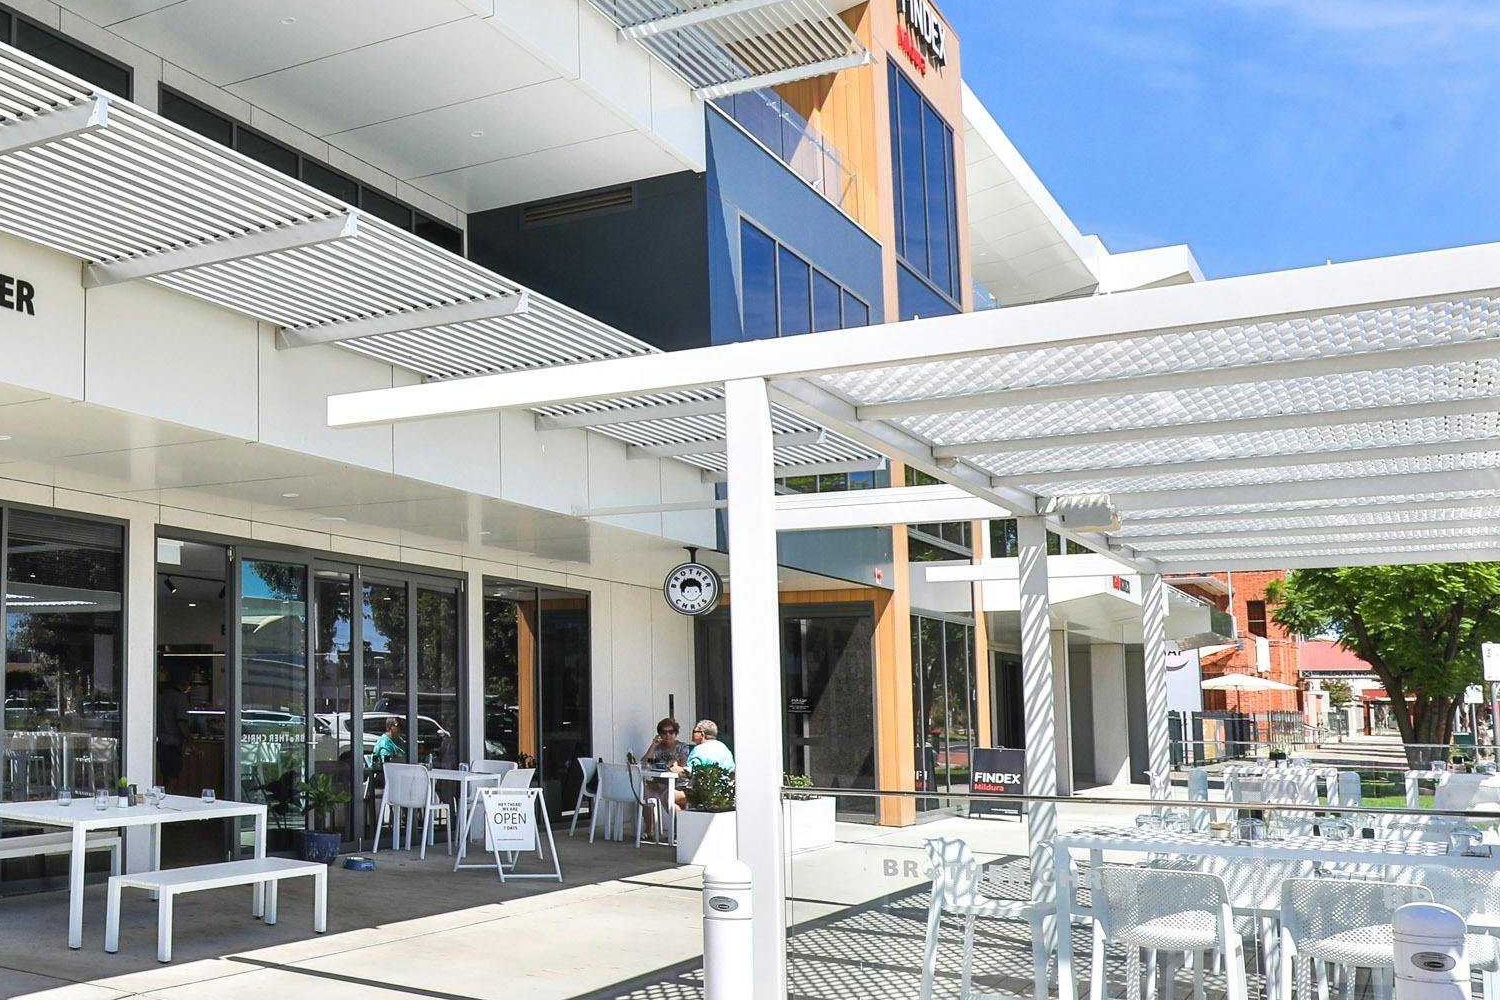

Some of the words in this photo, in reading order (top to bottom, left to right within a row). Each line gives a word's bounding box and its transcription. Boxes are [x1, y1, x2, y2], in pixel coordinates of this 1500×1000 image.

[671, 569, 712, 588] BROTHER
[675, 599, 708, 610] CHRIS
[974, 772, 1021, 784] FINDEX
[974, 783, 1005, 792] Mildura
[493, 812, 527, 825] OPEN
